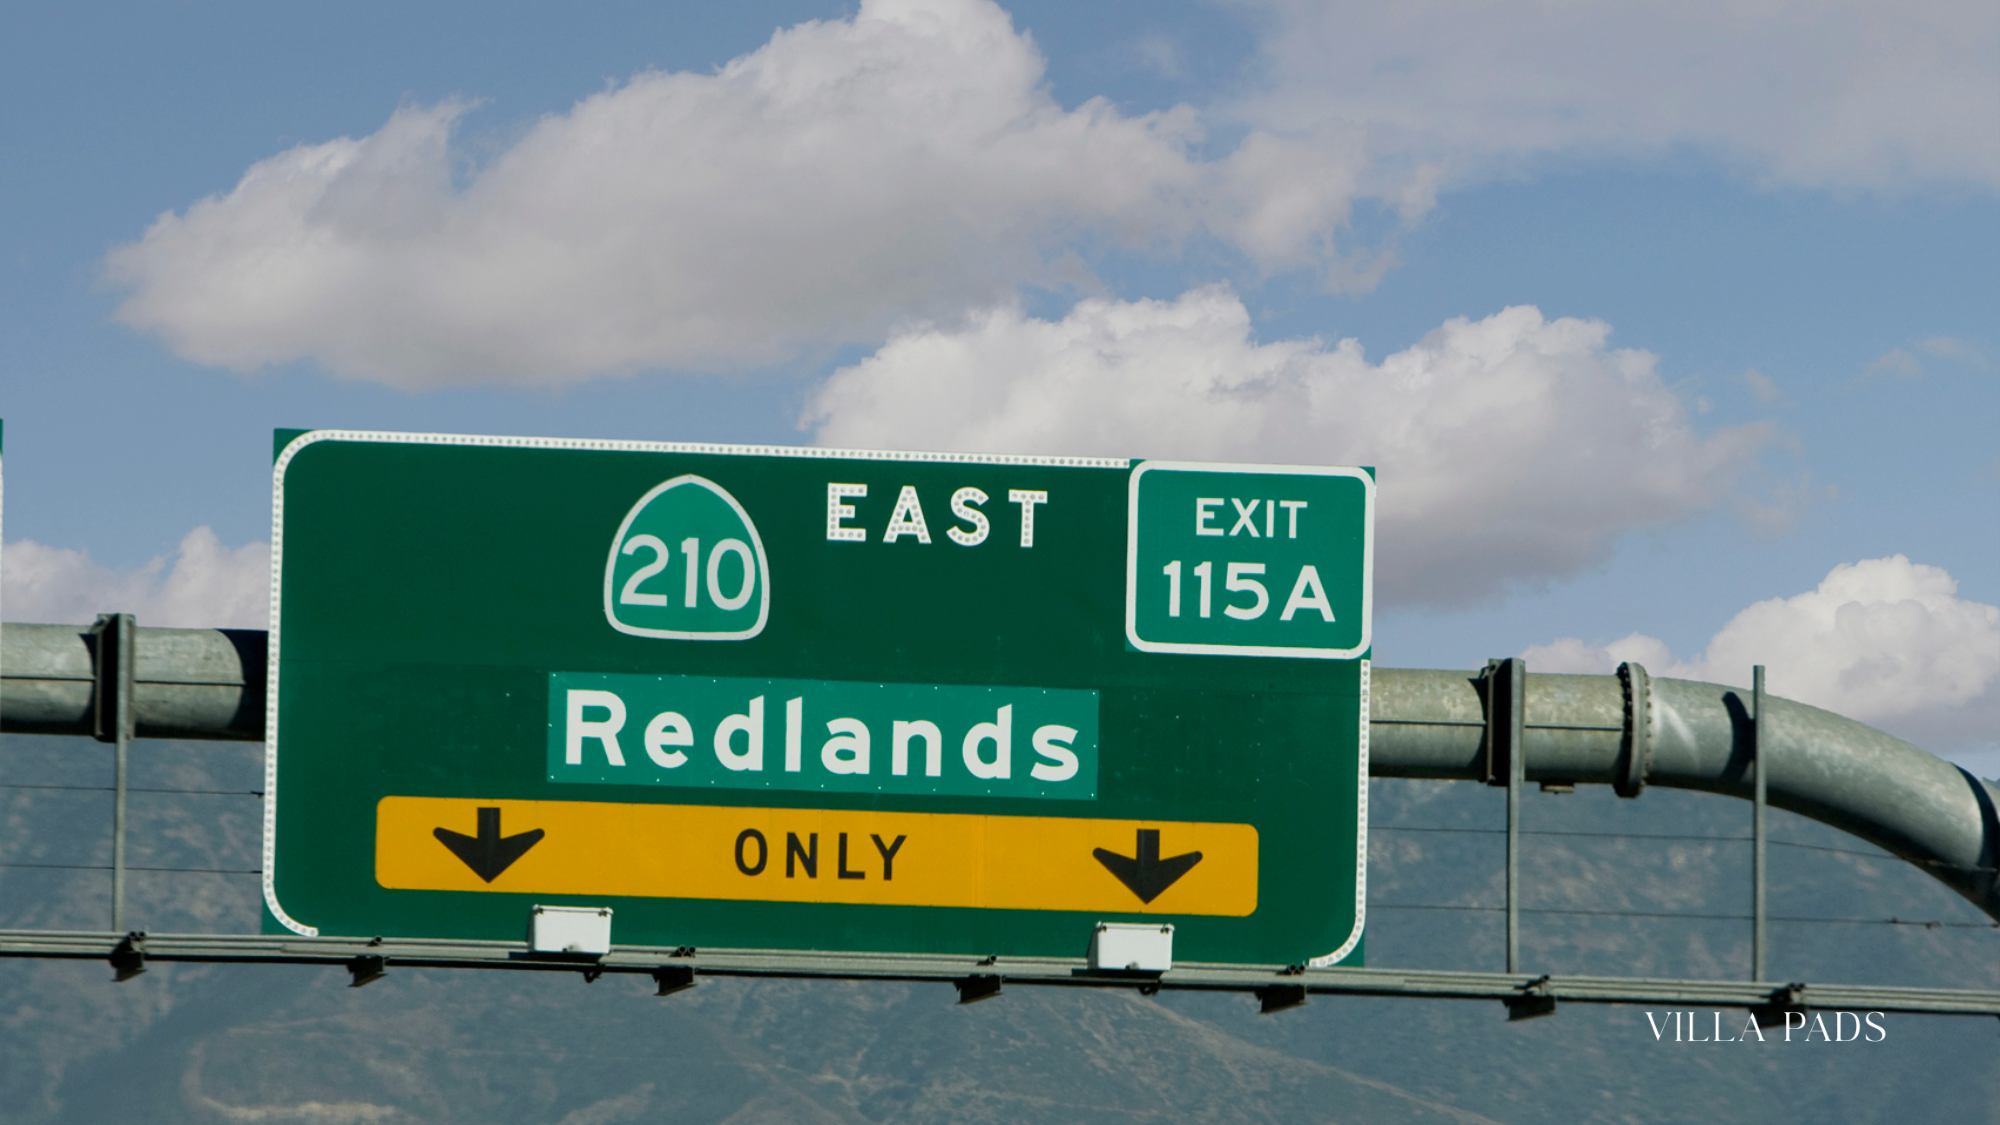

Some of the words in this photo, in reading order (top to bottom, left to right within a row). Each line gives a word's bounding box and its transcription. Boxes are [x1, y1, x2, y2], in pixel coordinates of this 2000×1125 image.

[826, 483, 1048, 547] EAST
[1196, 497, 1308, 539] EXIT
[619, 534, 756, 610] 210
[1163, 560, 1336, 622] 115A
[565, 689, 1079, 782] Redlands
[734, 828, 908, 881] ONLY
